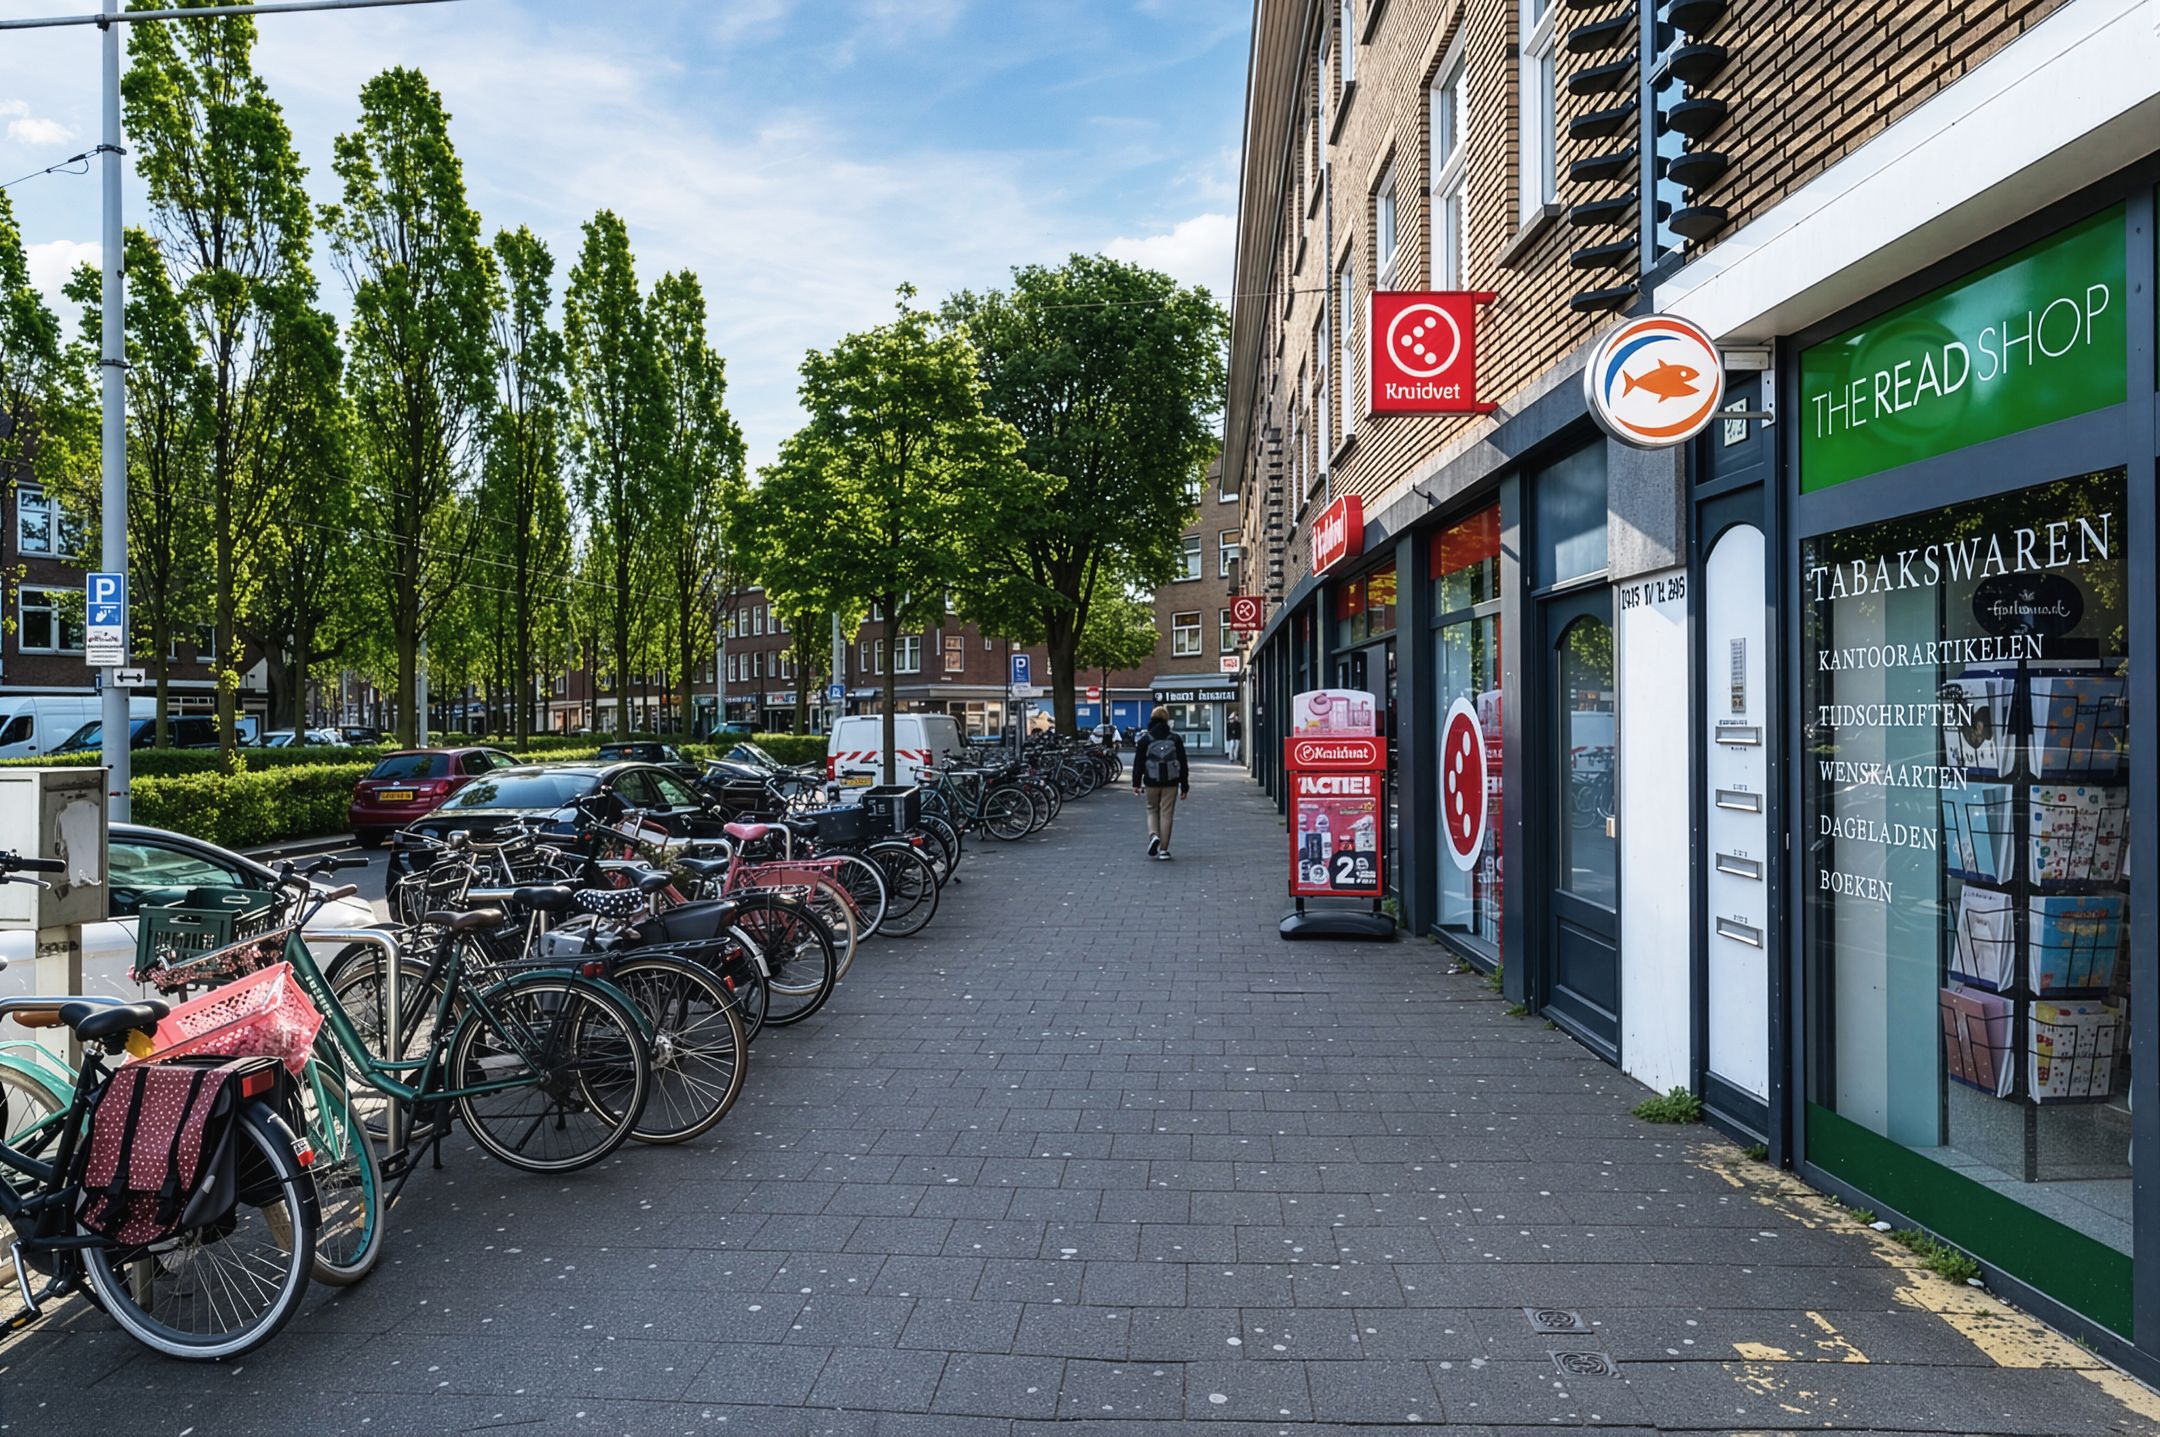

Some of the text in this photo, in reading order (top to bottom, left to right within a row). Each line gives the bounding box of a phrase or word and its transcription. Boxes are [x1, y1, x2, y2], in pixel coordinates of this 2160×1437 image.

[1812, 376, 1868, 438] THE
[1874, 341, 1970, 419] READ
[1977, 283, 2110, 382] SHOP
[1810, 512, 2112, 603] TABAKSWAREN
[94, 577, 116, 605] P
[1819, 633, 2044, 672] KANTOORARTIKELEN
[1819, 760, 1968, 791] WENSKAARTEN
[1820, 814, 1938, 851] DAGELADEN
[1820, 869, 1893, 904] BOEKEN
